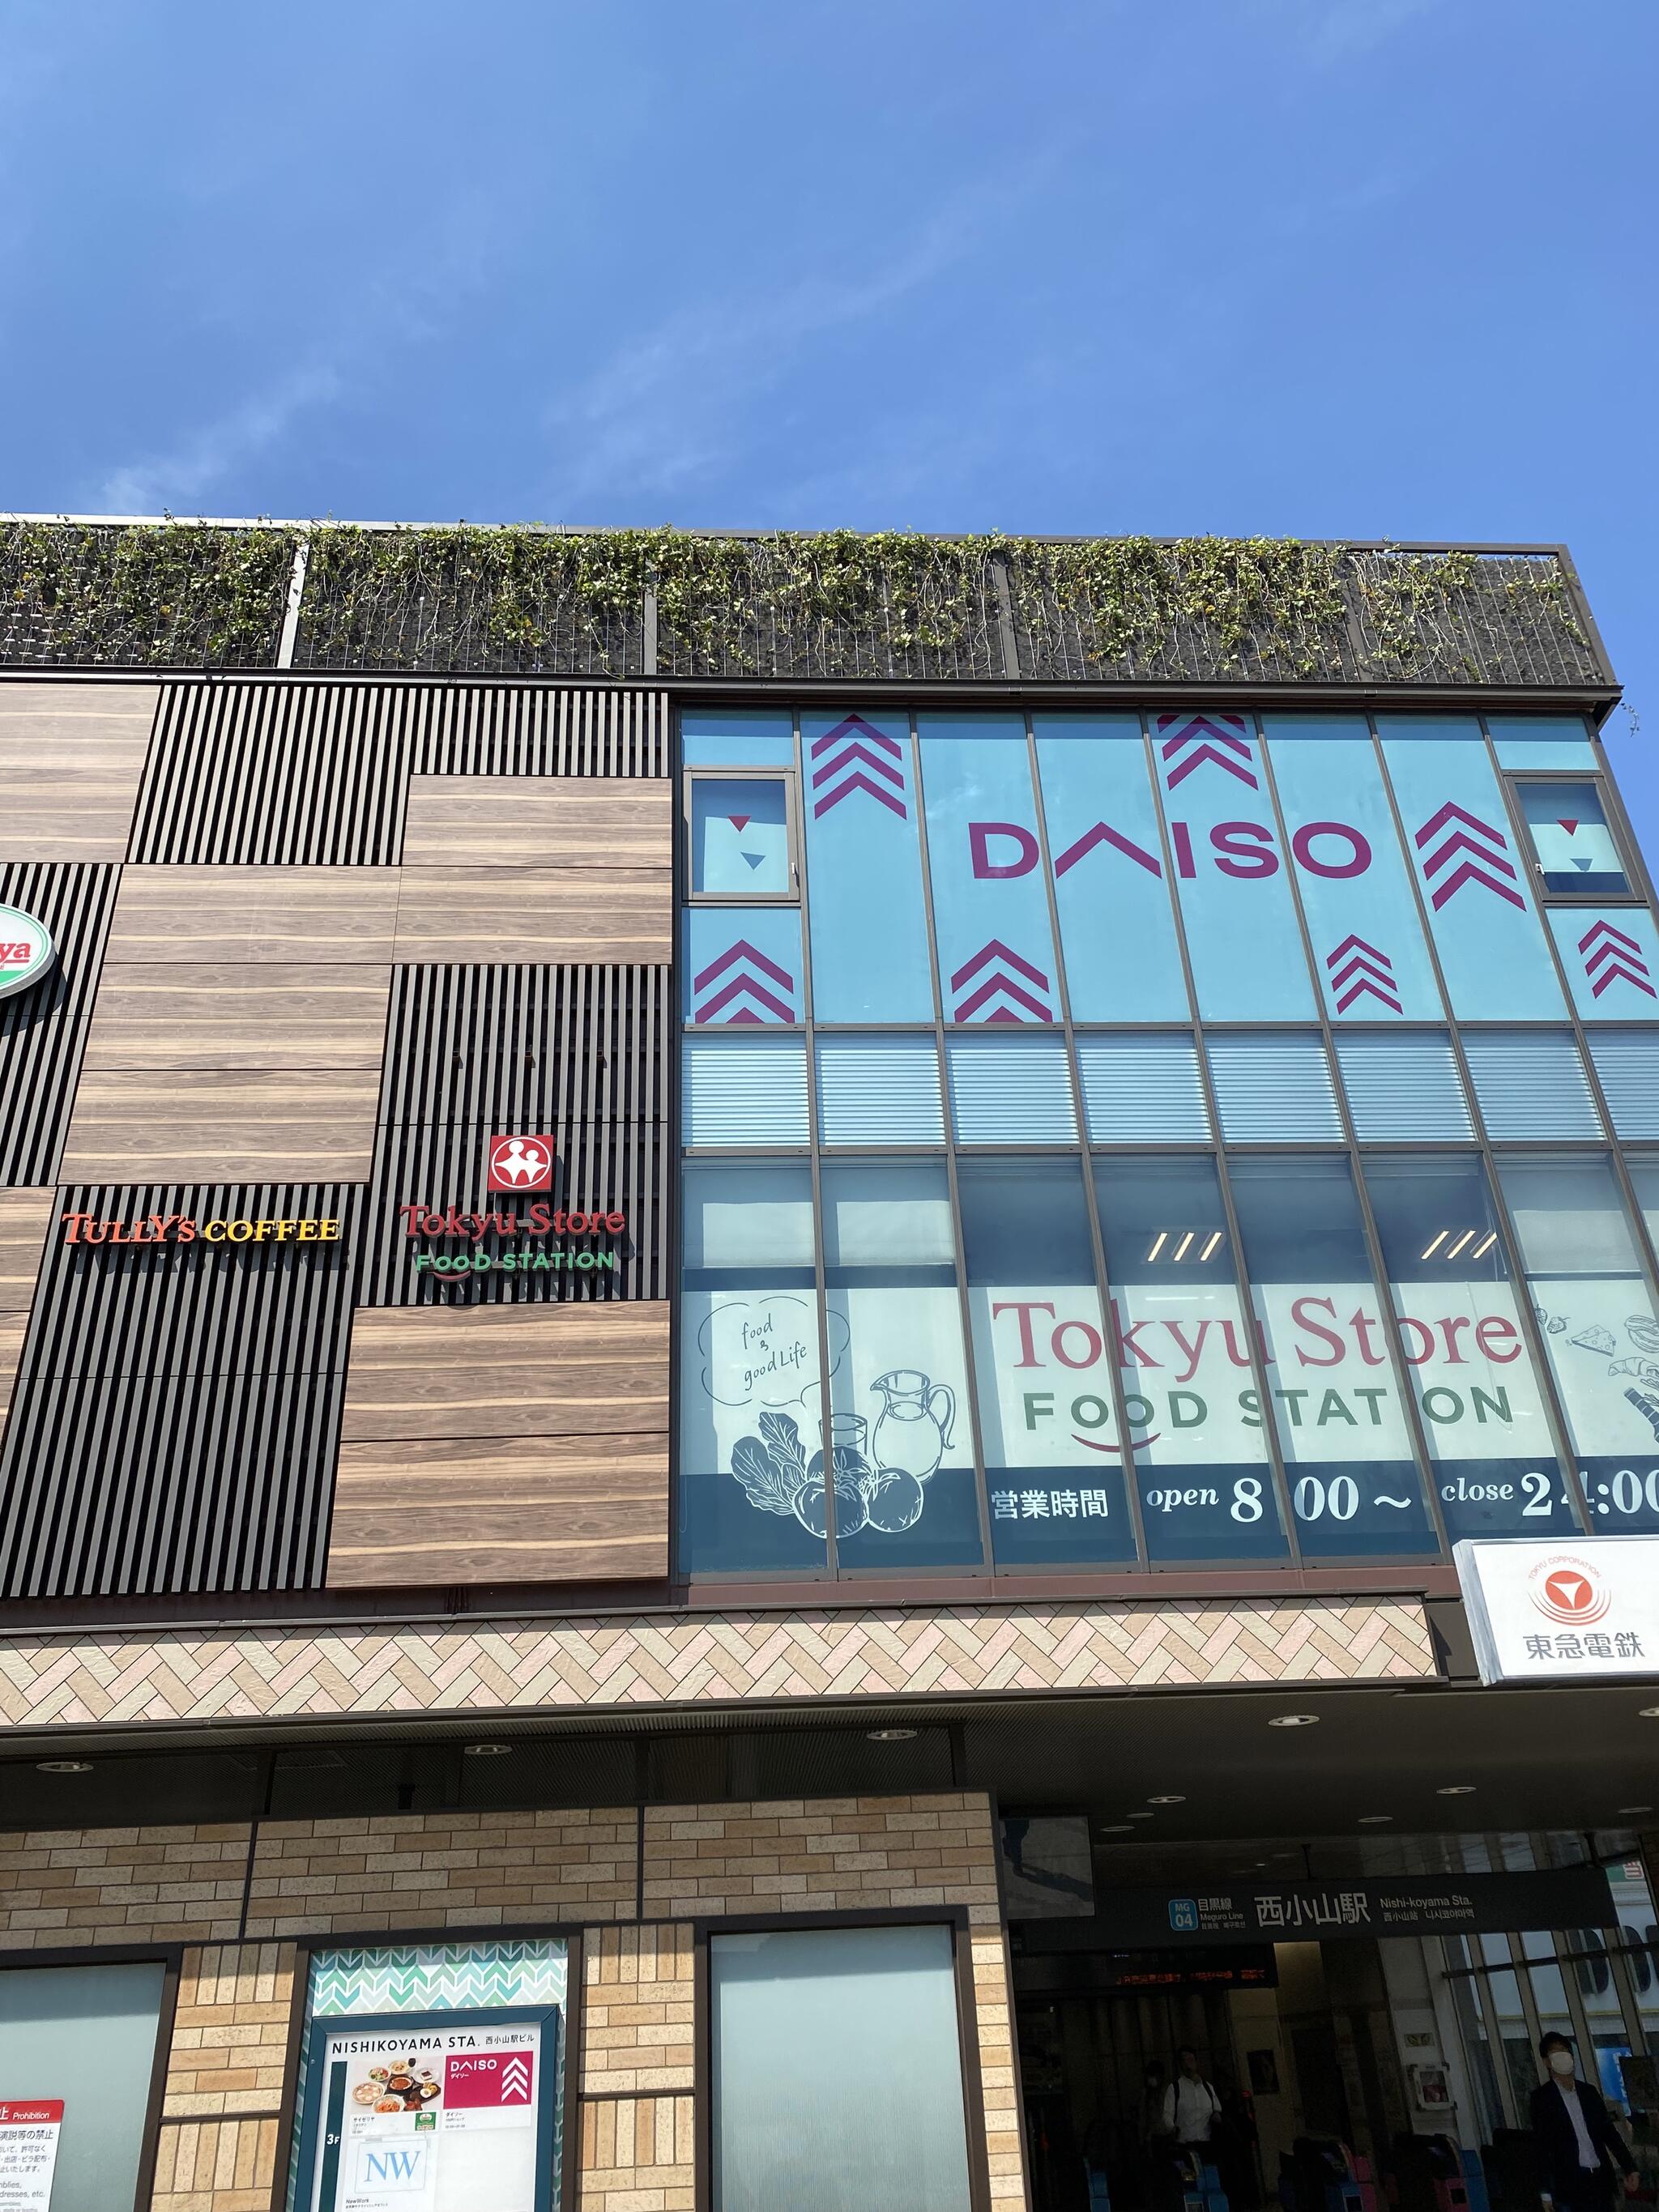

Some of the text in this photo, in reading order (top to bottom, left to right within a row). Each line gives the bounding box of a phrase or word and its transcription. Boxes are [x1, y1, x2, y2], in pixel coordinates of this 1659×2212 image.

[968, 820, 1373, 880] DAISO
[204, 1219, 340, 1242] COFFEE
[399, 1204, 625, 1242] Tokyu Store
[416, 1251, 614, 1273] FOOD STATION
[741, 1312, 774, 1350] food
[992, 1296, 1523, 1383] Tokyu Store
[744, 1340, 808, 1391] good Life
[1023, 1386, 1514, 1431] FOOD STATON
[1146, 1486, 1219, 1513] open
[1441, 1477, 1514, 1502] close
[991, 1489, 1109, 1520] 営業時間
[1529, 1555, 1602, 1581] TOKYU CORPORATION
[1523, 1631, 1646, 1660] 東急電鉄
[1175, 1903, 1190, 1912] MG
[1198, 1898, 1233, 1912] 目黒線
[1255, 1892, 1371, 1928] 西小山駅
[1380, 1894, 1473, 1909] Nishi-koyama Sta.
[1175, 1913, 1193, 1928] 04
[1200, 1912, 1244, 1922] Meguro Line
[332, 2035, 480, 2054] NISHIKOYAMA STA.
[485, 2034, 535, 2045] 西小山駅ビル
[450, 2059, 497, 2072] DAISO
[13, 2112, 49, 2120] Prohibition
[326, 2134, 340, 2145] 3F
[364, 2150, 421, 2182] NW
[32, 2190, 45, 2198] etc.
